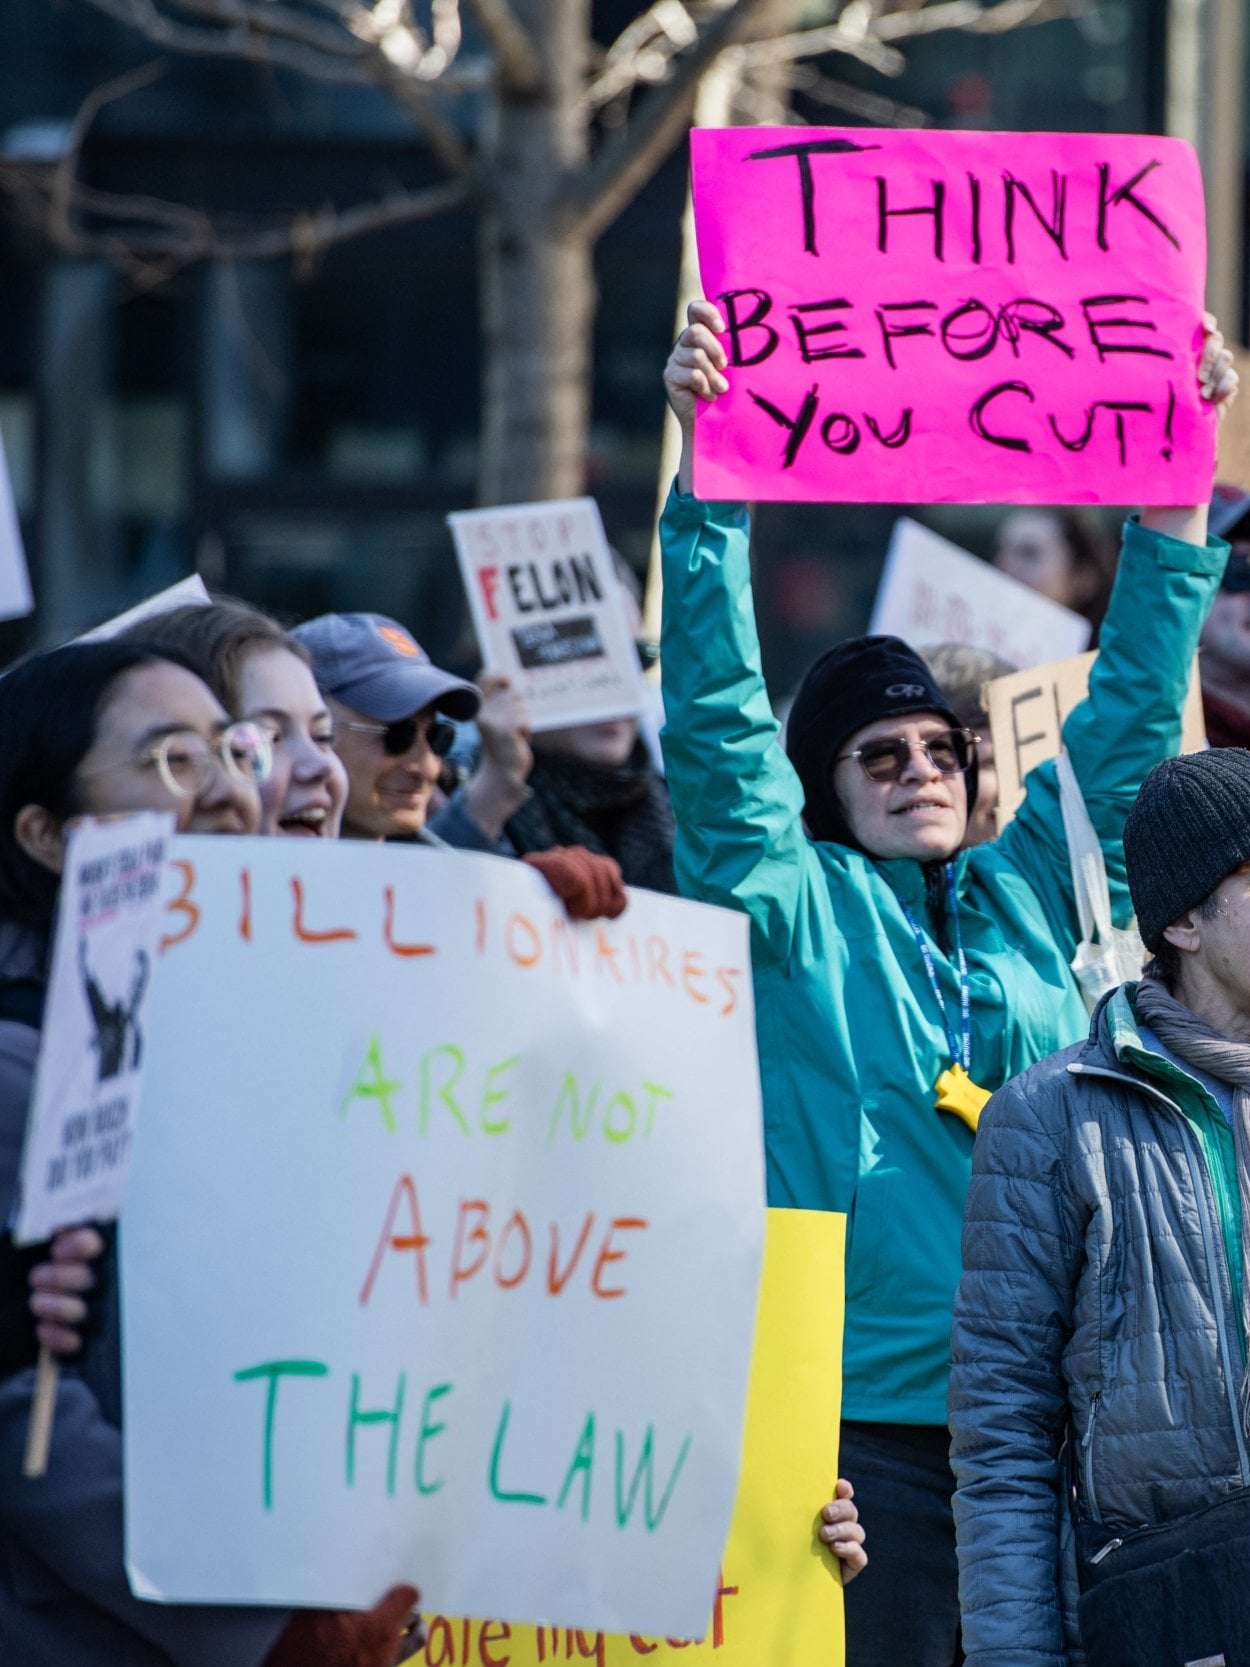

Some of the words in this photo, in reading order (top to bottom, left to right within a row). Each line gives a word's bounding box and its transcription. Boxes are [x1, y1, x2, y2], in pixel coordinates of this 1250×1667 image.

[743, 139, 1181, 264] THINK
[717, 289, 1174, 370] BEFORE
[968, 380, 1179, 466] CUT!
[478, 553, 605, 623] FELON
[339, 1032, 520, 1137] ARE
[547, 1072, 674, 1150] NOT
[359, 1173, 648, 1304] ABOVE
[233, 1360, 455, 1514] THE
[487, 1402, 694, 1534] LAW
